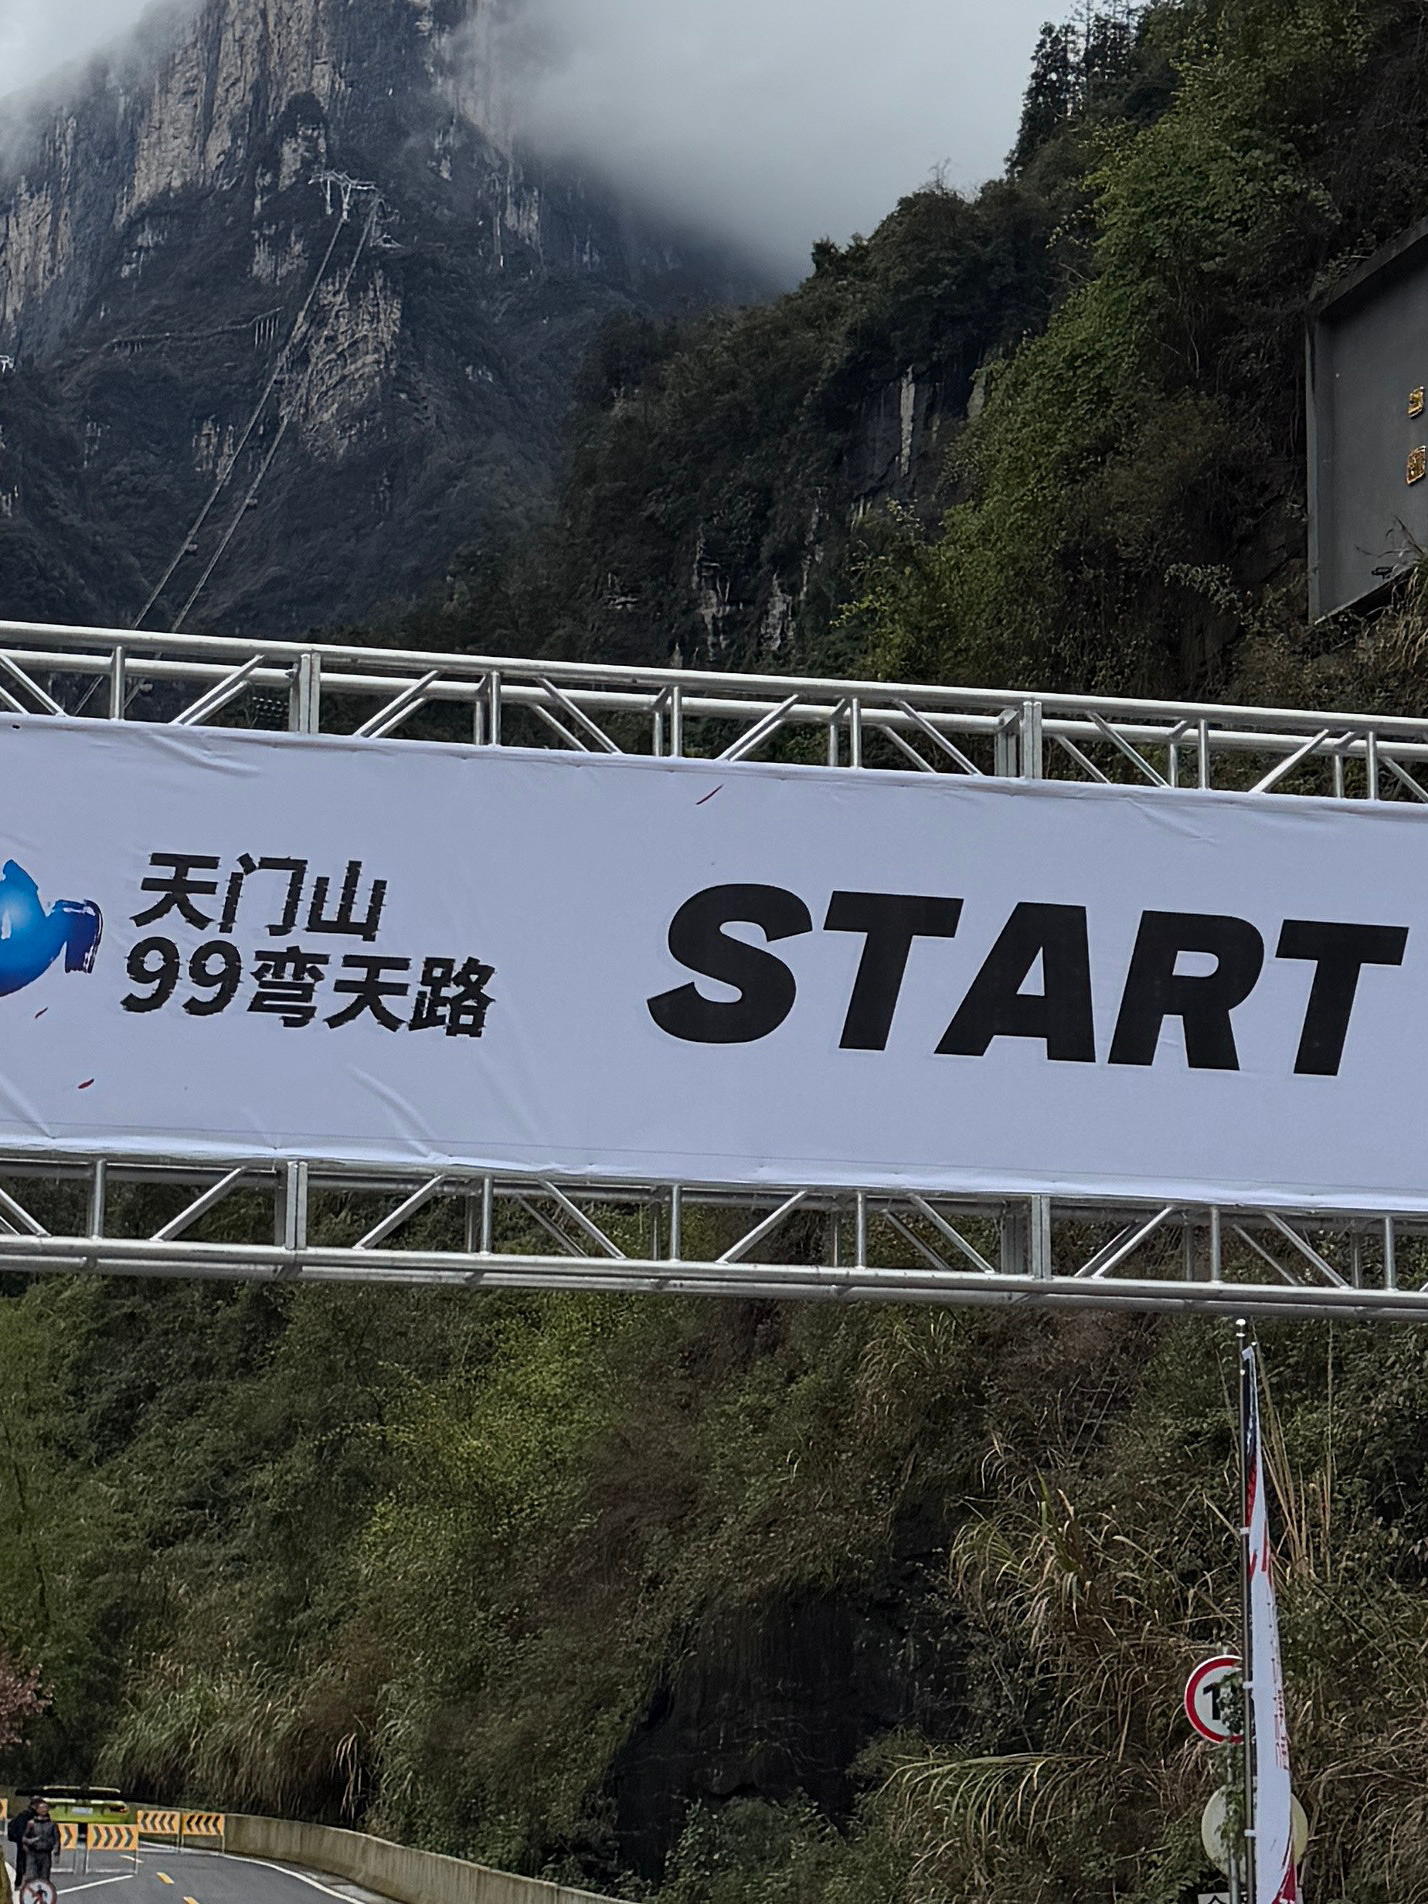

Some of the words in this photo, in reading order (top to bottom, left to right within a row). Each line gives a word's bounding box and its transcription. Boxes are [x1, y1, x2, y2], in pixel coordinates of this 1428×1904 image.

[131, 852, 388, 942] 天门山
[121, 937, 497, 1038] 99弯天路
[646, 882, 1410, 1077] START
